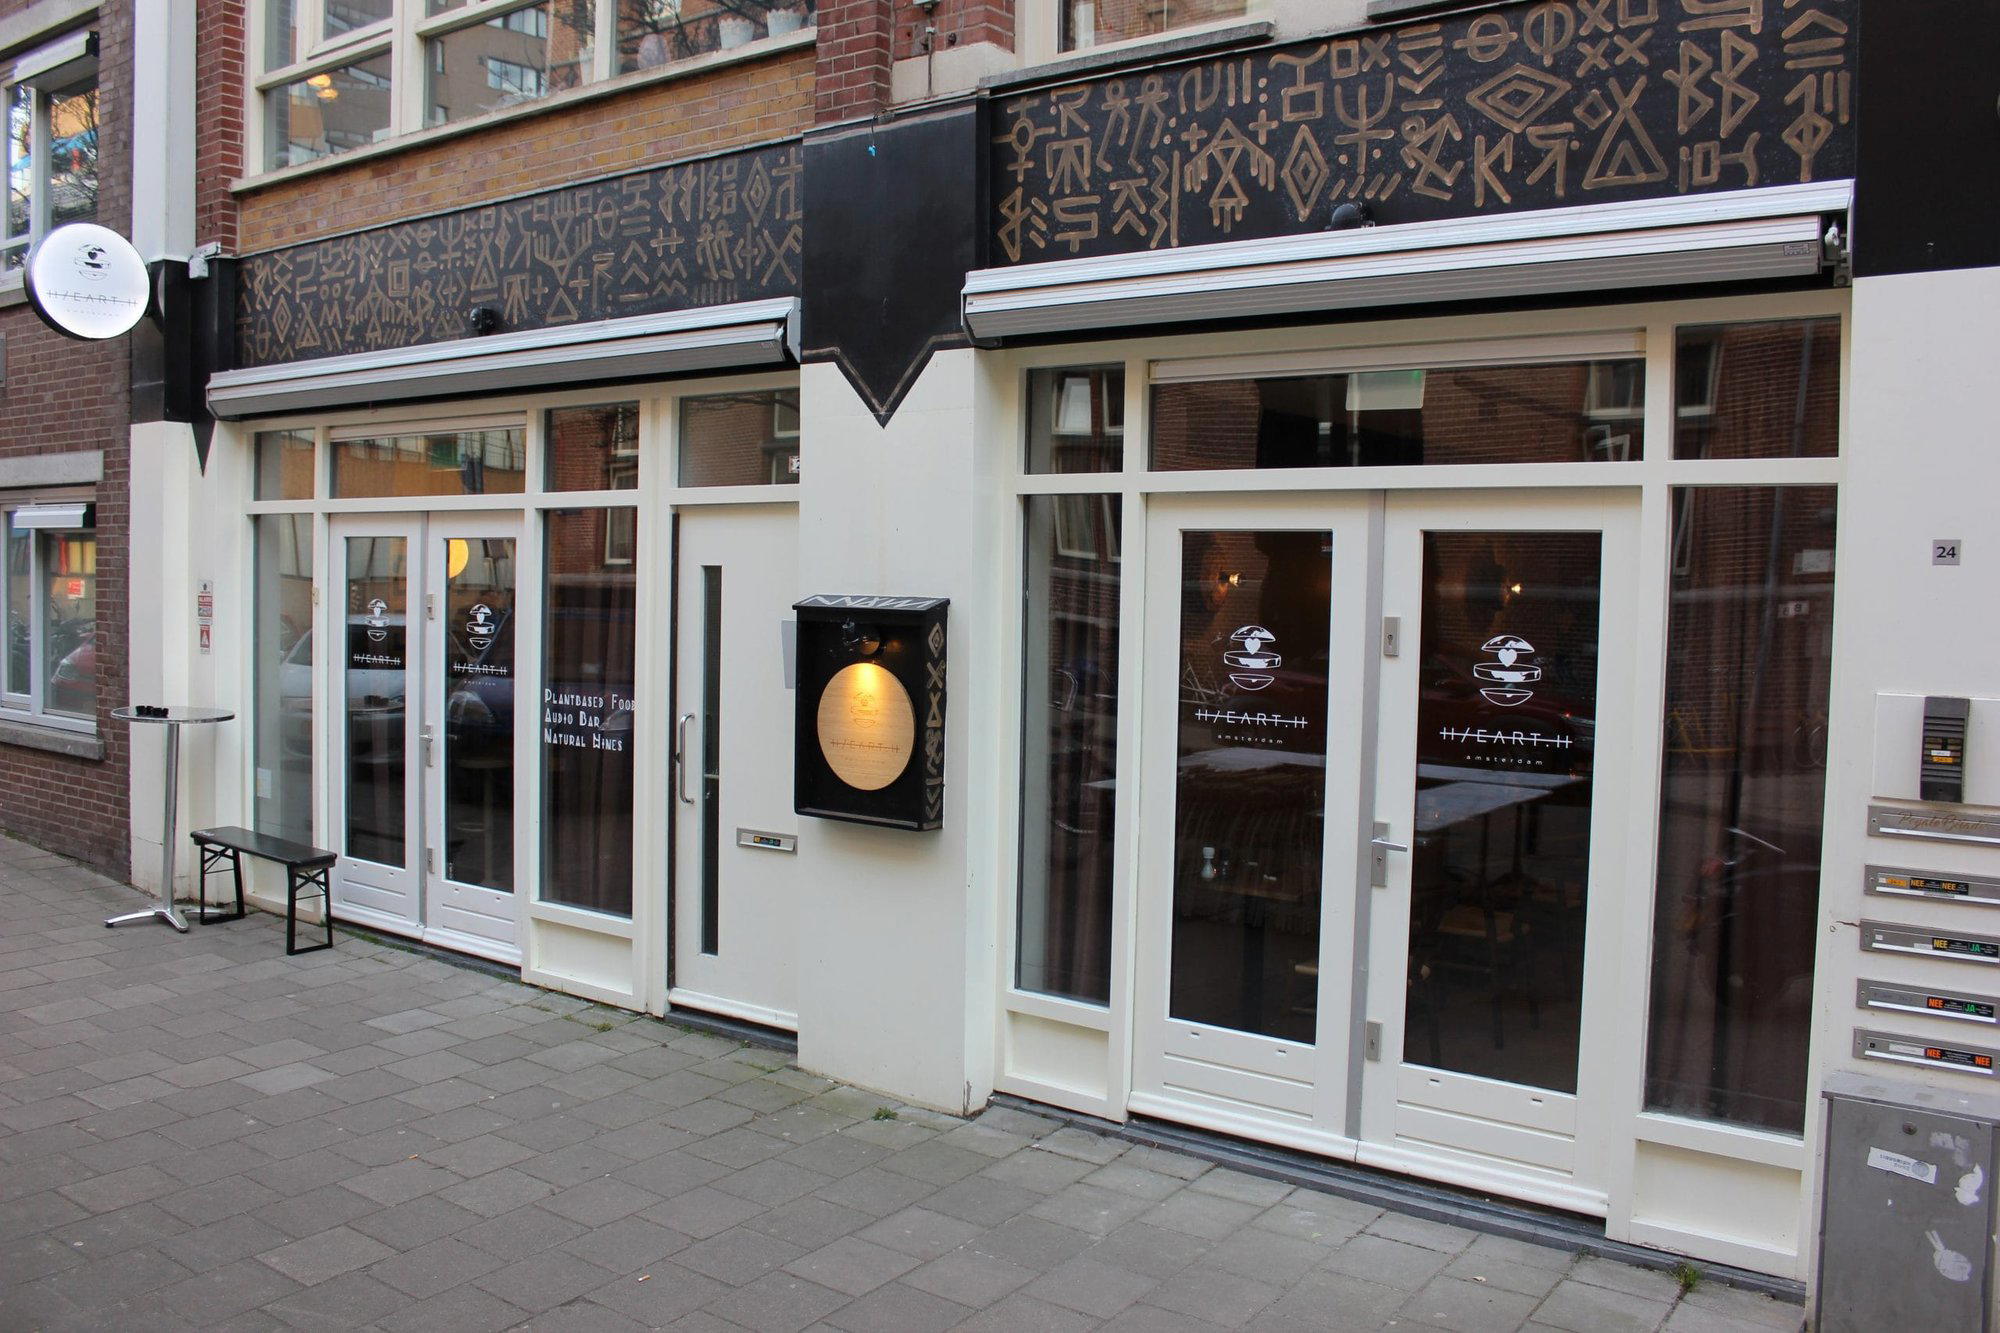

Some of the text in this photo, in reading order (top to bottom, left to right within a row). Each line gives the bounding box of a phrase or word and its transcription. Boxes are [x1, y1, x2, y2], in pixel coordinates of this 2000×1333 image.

[1936, 546, 1956, 558] 24
[545, 708, 600, 728] AUDIO BAR
[544, 728, 586, 748] NATURAL
[1218, 734, 1283, 744] amsterdam
[1466, 755, 1542, 765] amsterdam
[1911, 879, 1926, 888] NEE
[1942, 882, 1957, 891] NEE
[1934, 939, 1949, 949] NEE
[1971, 943, 1981, 952] JA
[1928, 998, 1944, 1008] NEE
[1965, 1003, 1976, 1013] JA
[1926, 1048, 1941, 1058] NEE
[1975, 1056, 1991, 1067] NEE
